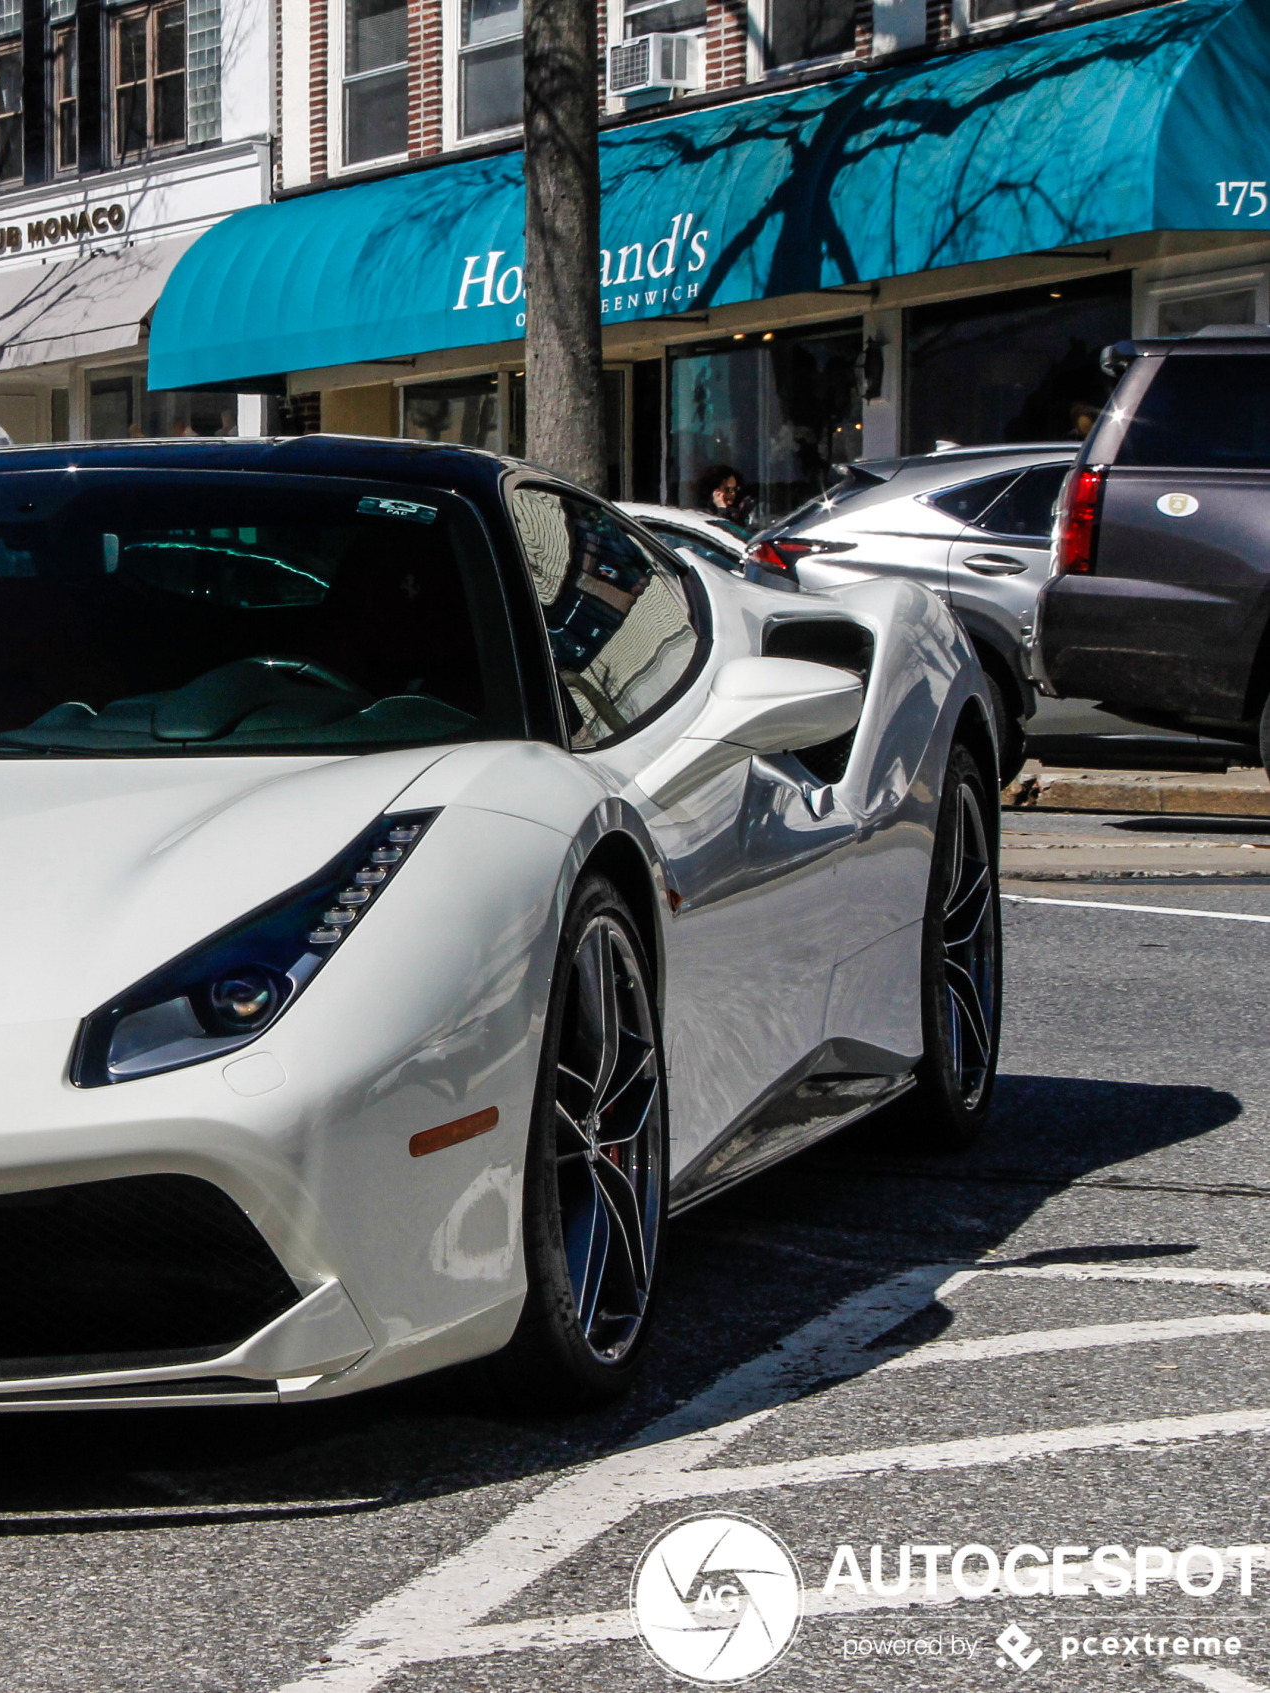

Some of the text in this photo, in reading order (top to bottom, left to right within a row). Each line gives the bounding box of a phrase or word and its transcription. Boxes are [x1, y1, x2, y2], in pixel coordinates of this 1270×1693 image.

[1215, 181, 1268, 217] 175
[27, 204, 126, 247] MONACO
[453, 212, 709, 311] Hoand's
